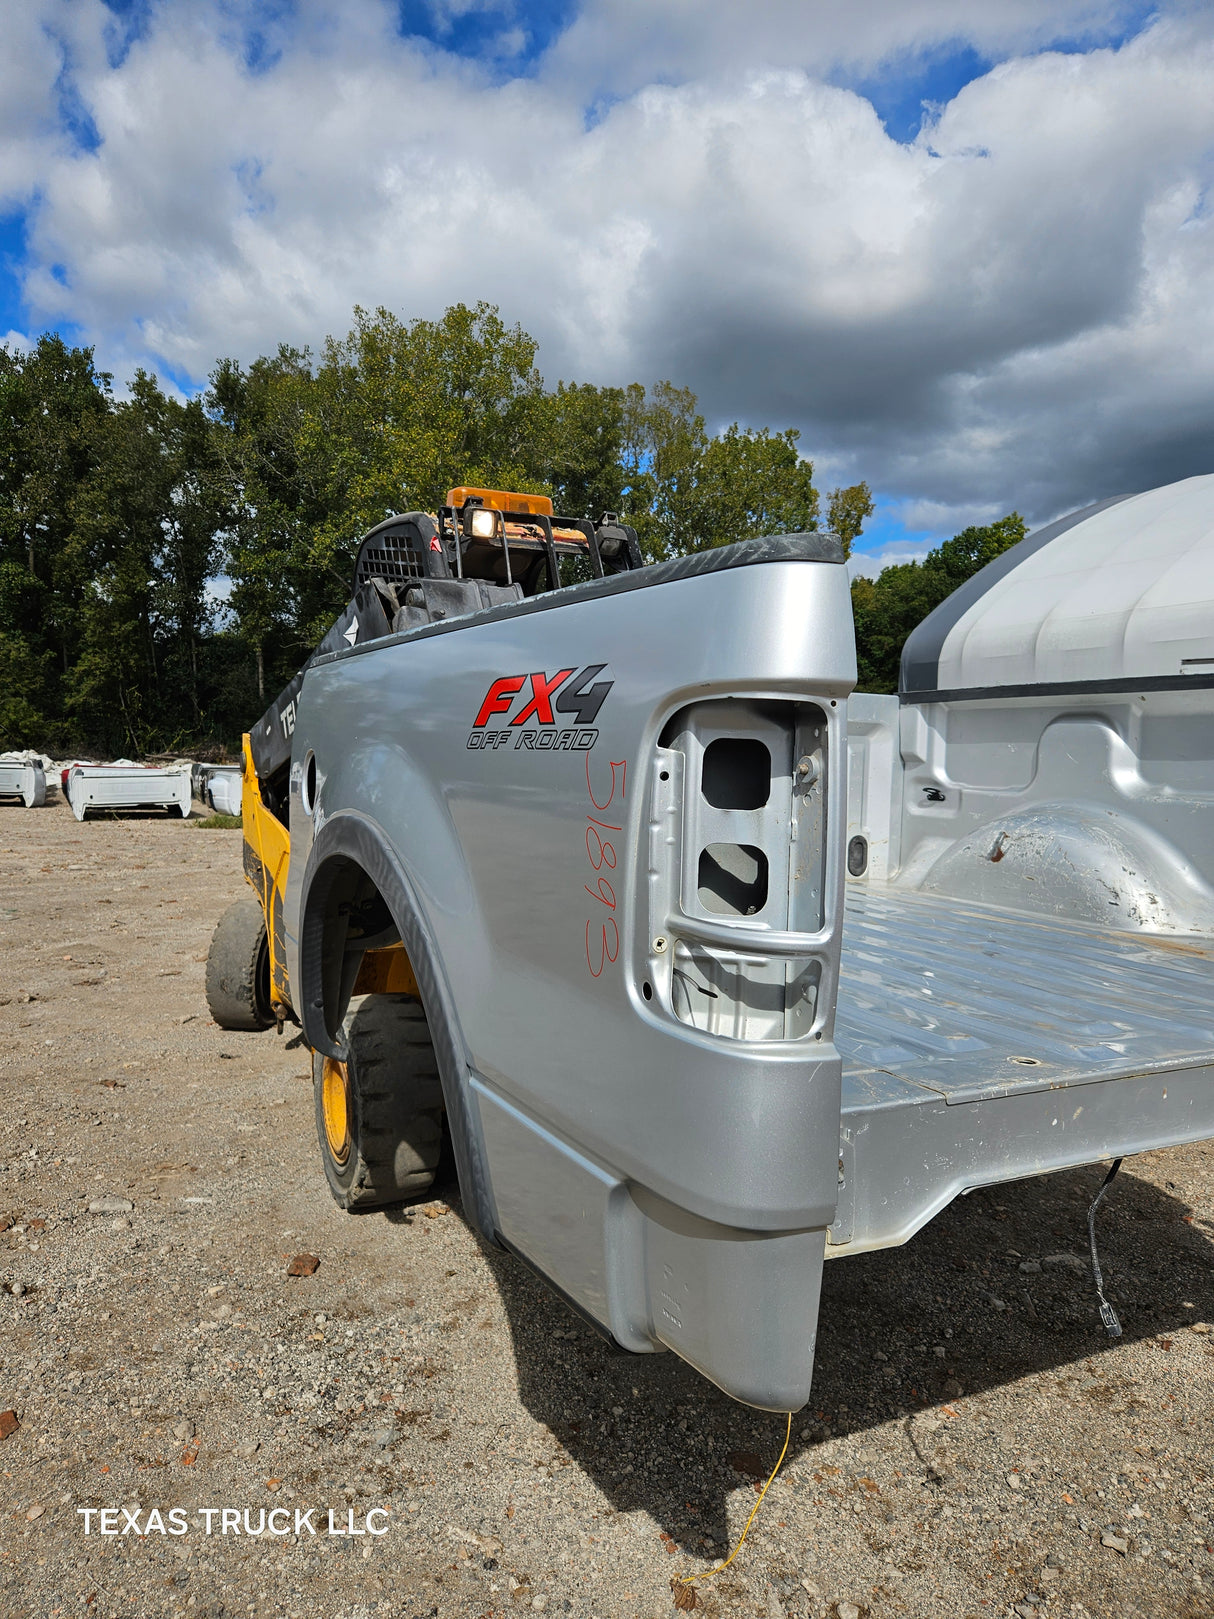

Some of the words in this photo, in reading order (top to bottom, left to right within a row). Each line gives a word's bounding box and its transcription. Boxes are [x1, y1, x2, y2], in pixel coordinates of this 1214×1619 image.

[472, 663, 615, 728] FX4
[466, 730, 511, 750] OFF
[514, 728, 600, 750] ROAD
[584, 750, 627, 978] 51893
